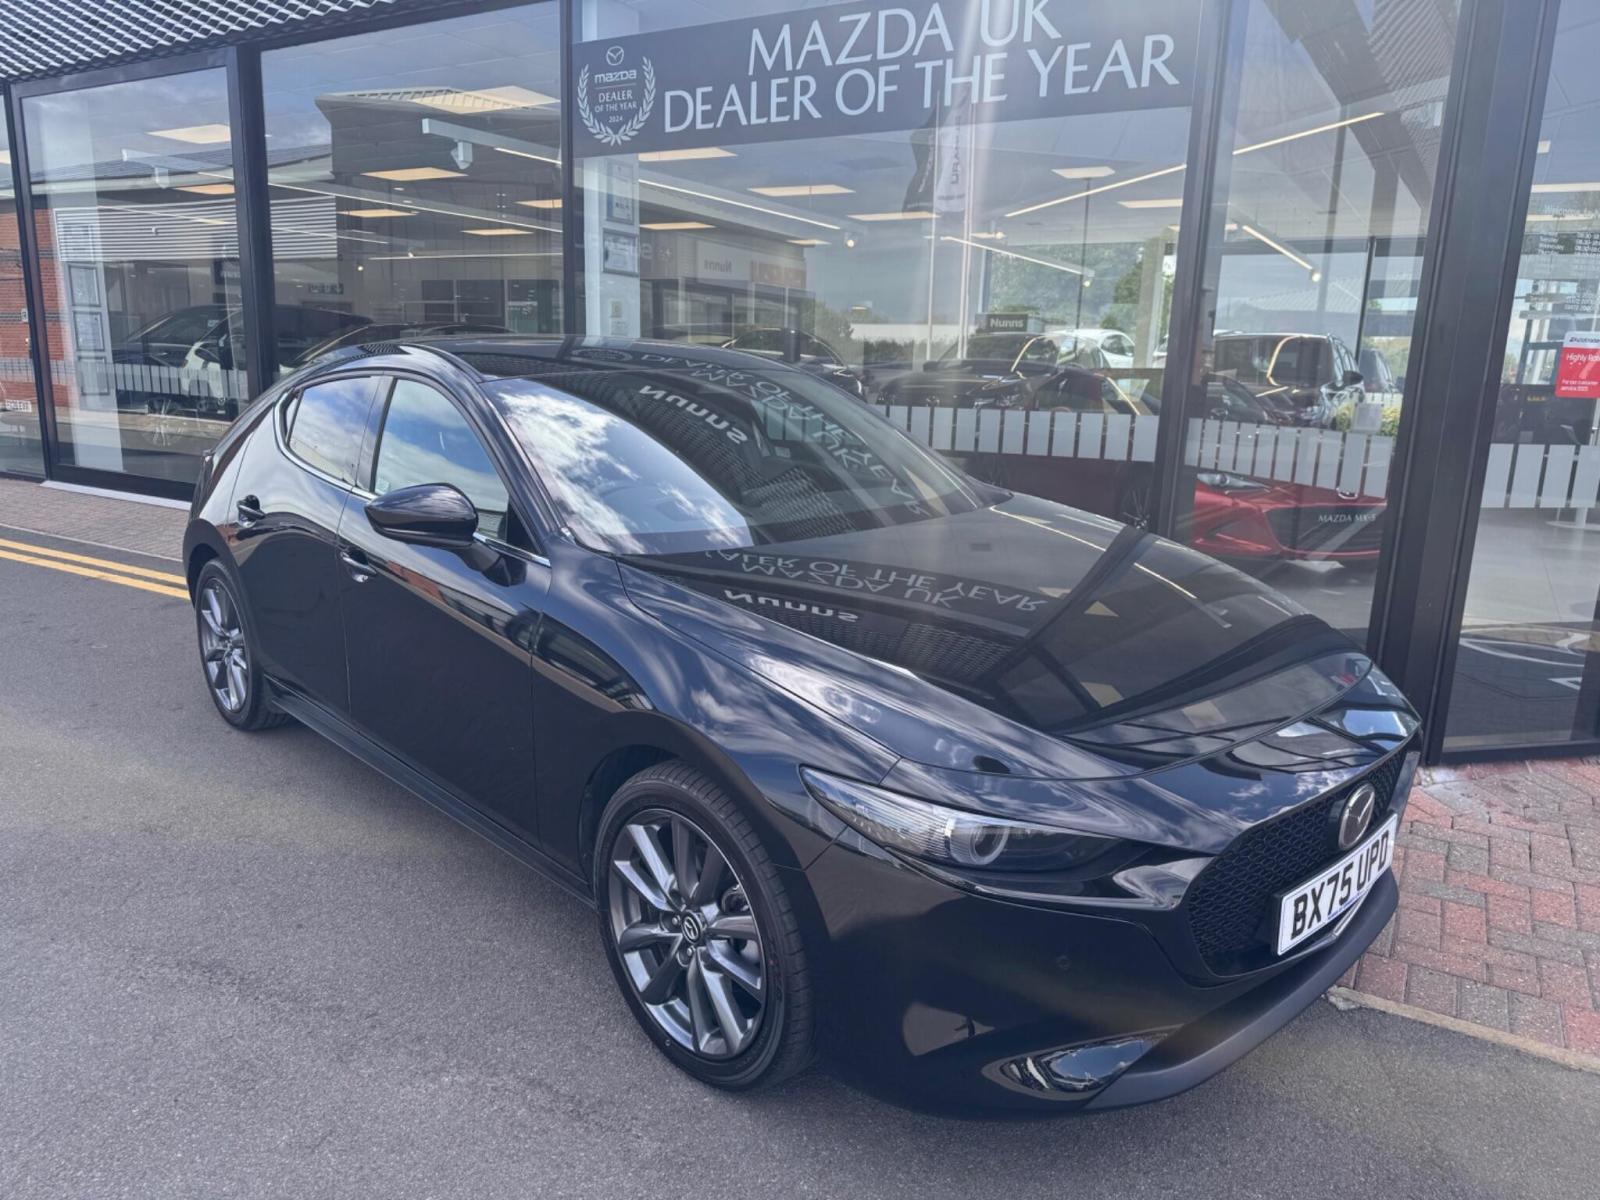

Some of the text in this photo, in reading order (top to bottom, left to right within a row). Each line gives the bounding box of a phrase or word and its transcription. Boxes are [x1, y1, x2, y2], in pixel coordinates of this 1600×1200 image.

[748, 0, 1062, 76] MAZDA UK
[664, 34, 1180, 133] DEALER OF THE YEAR
[598, 89, 633, 103] DEALER
[594, 101, 638, 113] OF THE YEAR
[608, 115, 624, 123] 2024
[989, 318, 1024, 329] Nunns
[1566, 353, 1587, 364] Highly
[1318, 514, 1353, 523] MAZDA
[1290, 829, 1390, 941] BX75 UPD
